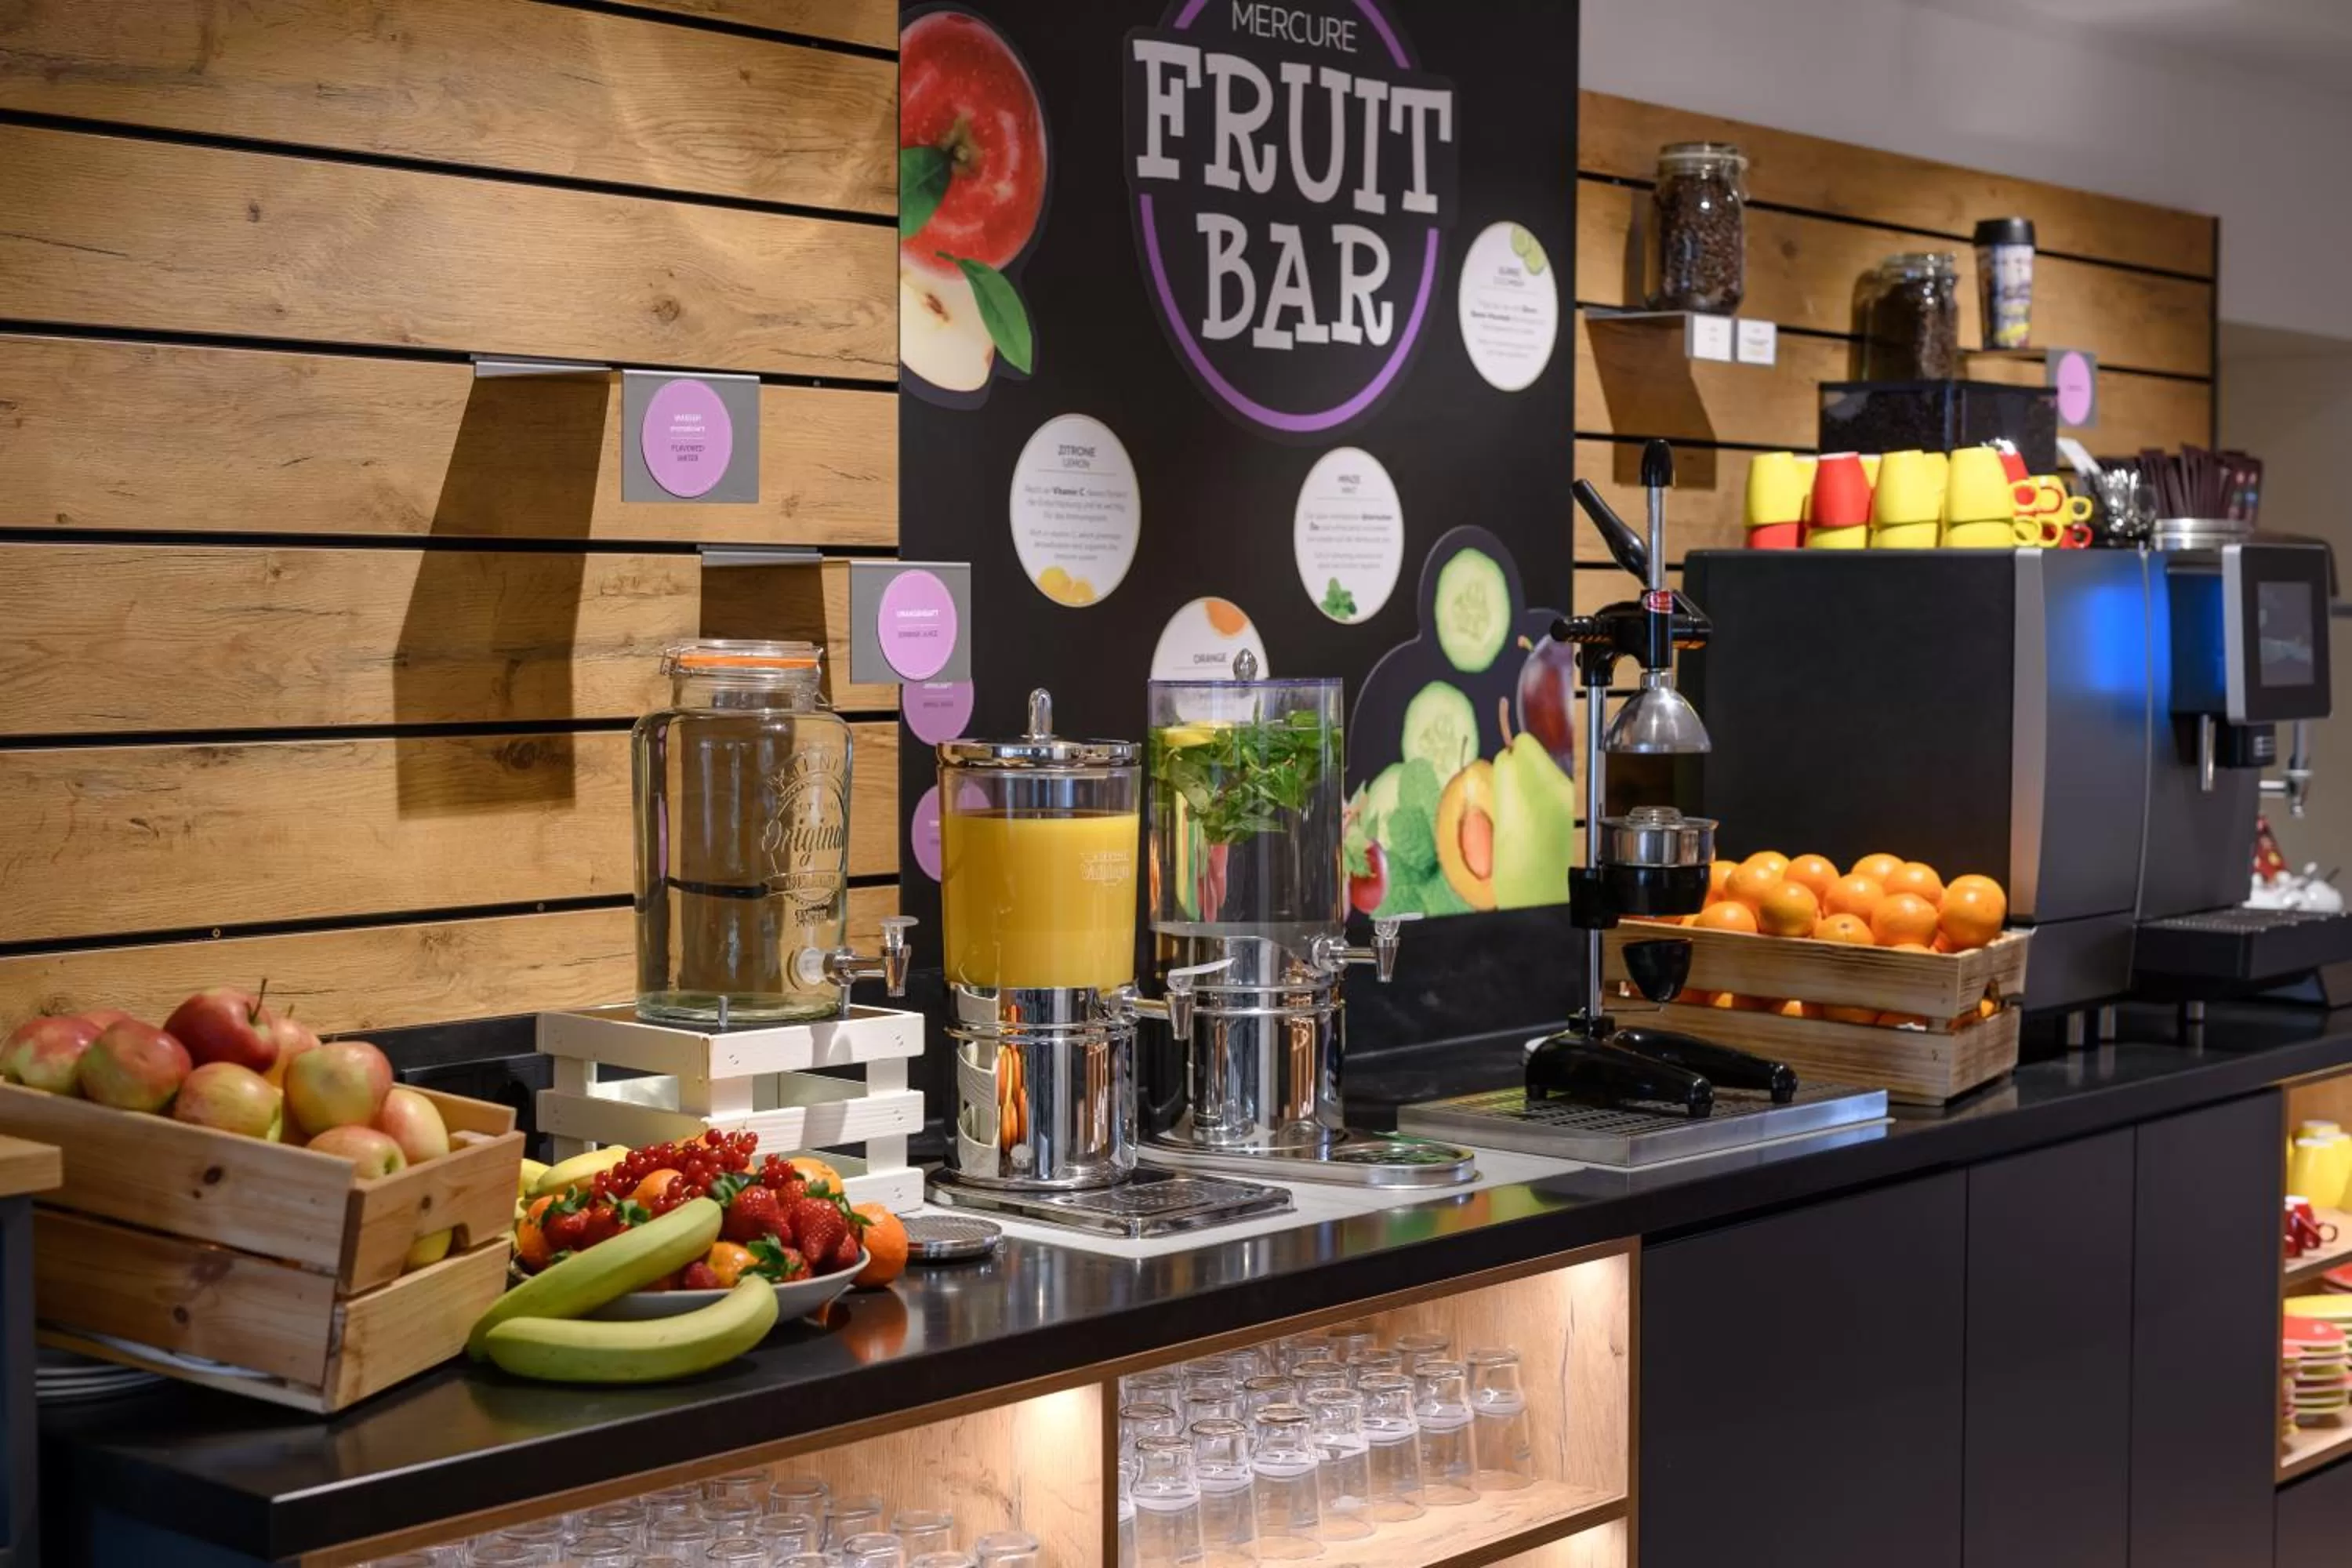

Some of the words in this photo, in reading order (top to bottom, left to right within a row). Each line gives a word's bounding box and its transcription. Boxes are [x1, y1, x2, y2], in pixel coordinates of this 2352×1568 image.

[1232, 0, 1357, 53] MERCURE
[1133, 39, 1452, 214] FRUIT
[1196, 212, 1393, 350] BAR
[1058, 444, 1097, 458] ZITRONE
[1192, 652, 1227, 664] ORANGE
